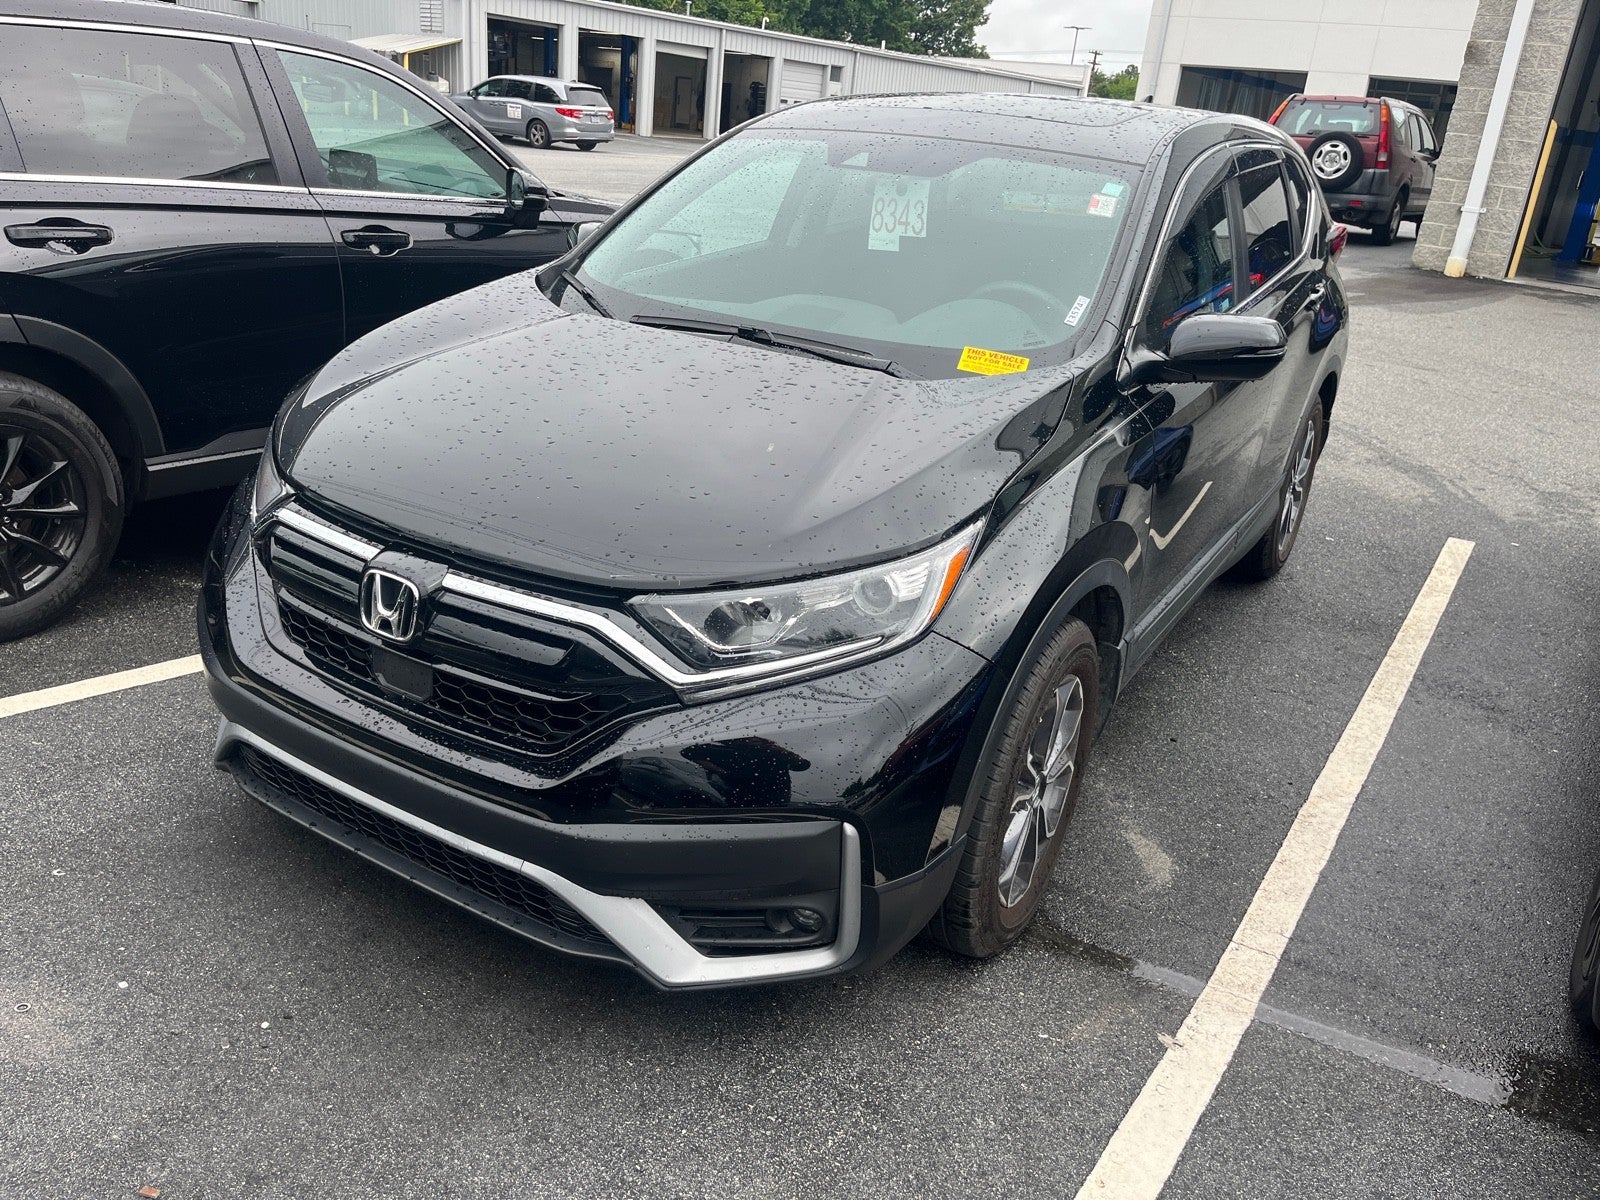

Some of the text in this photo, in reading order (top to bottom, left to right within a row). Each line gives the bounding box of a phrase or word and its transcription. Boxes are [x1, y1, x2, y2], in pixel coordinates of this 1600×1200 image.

[872, 196, 925, 236] 8343
[967, 348, 987, 357] THIS
[989, 352, 1026, 365] VEHICLE
[984, 357, 1000, 365] FOR
[1002, 361, 1022, 370] SALE
